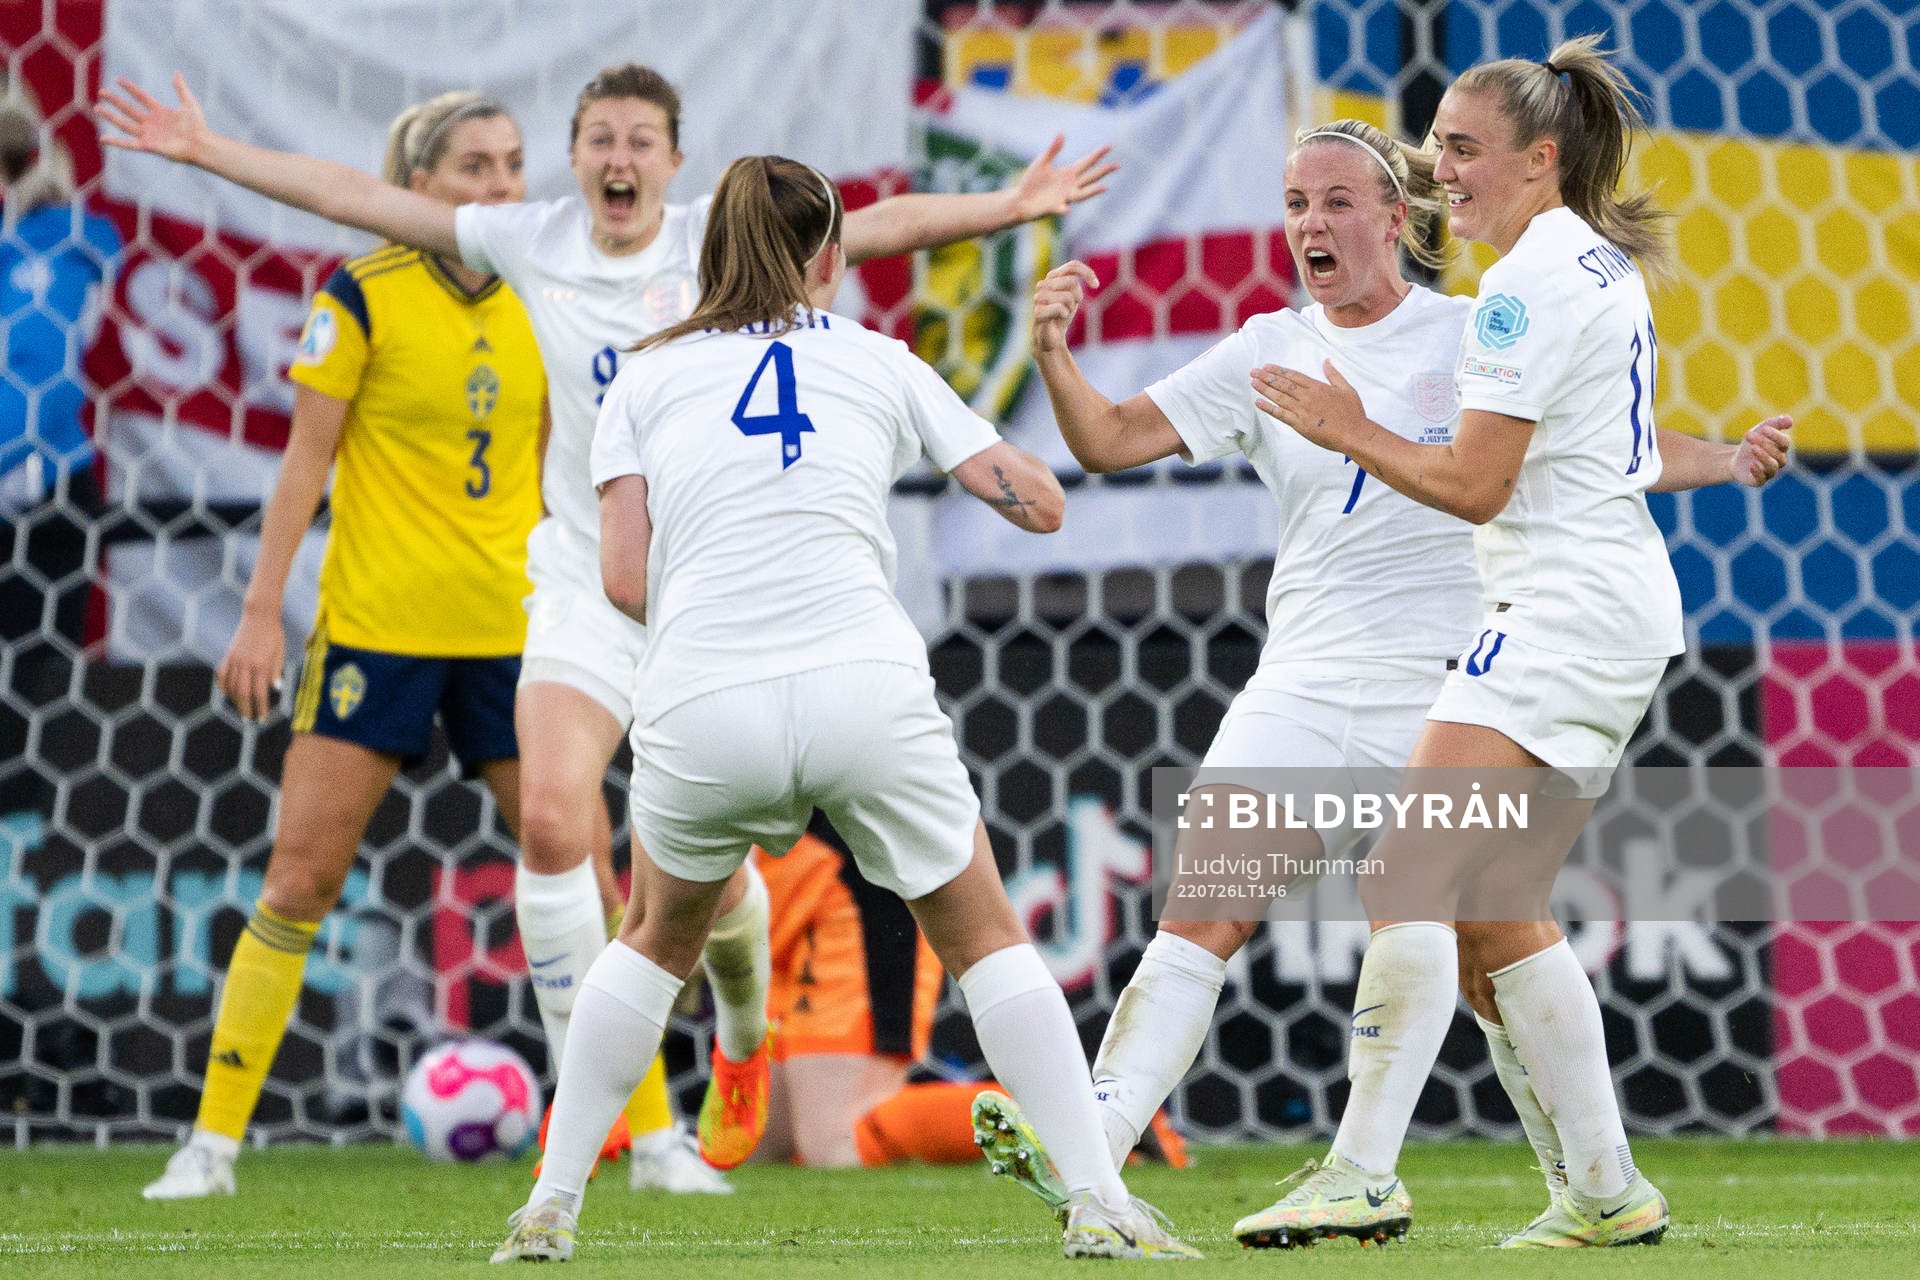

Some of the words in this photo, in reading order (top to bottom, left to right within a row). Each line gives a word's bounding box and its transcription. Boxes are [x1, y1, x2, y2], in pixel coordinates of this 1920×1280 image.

[731, 341, 816, 471] 4
[1465, 362, 1522, 379] FOUNDATION
[465, 429, 492, 500] 3
